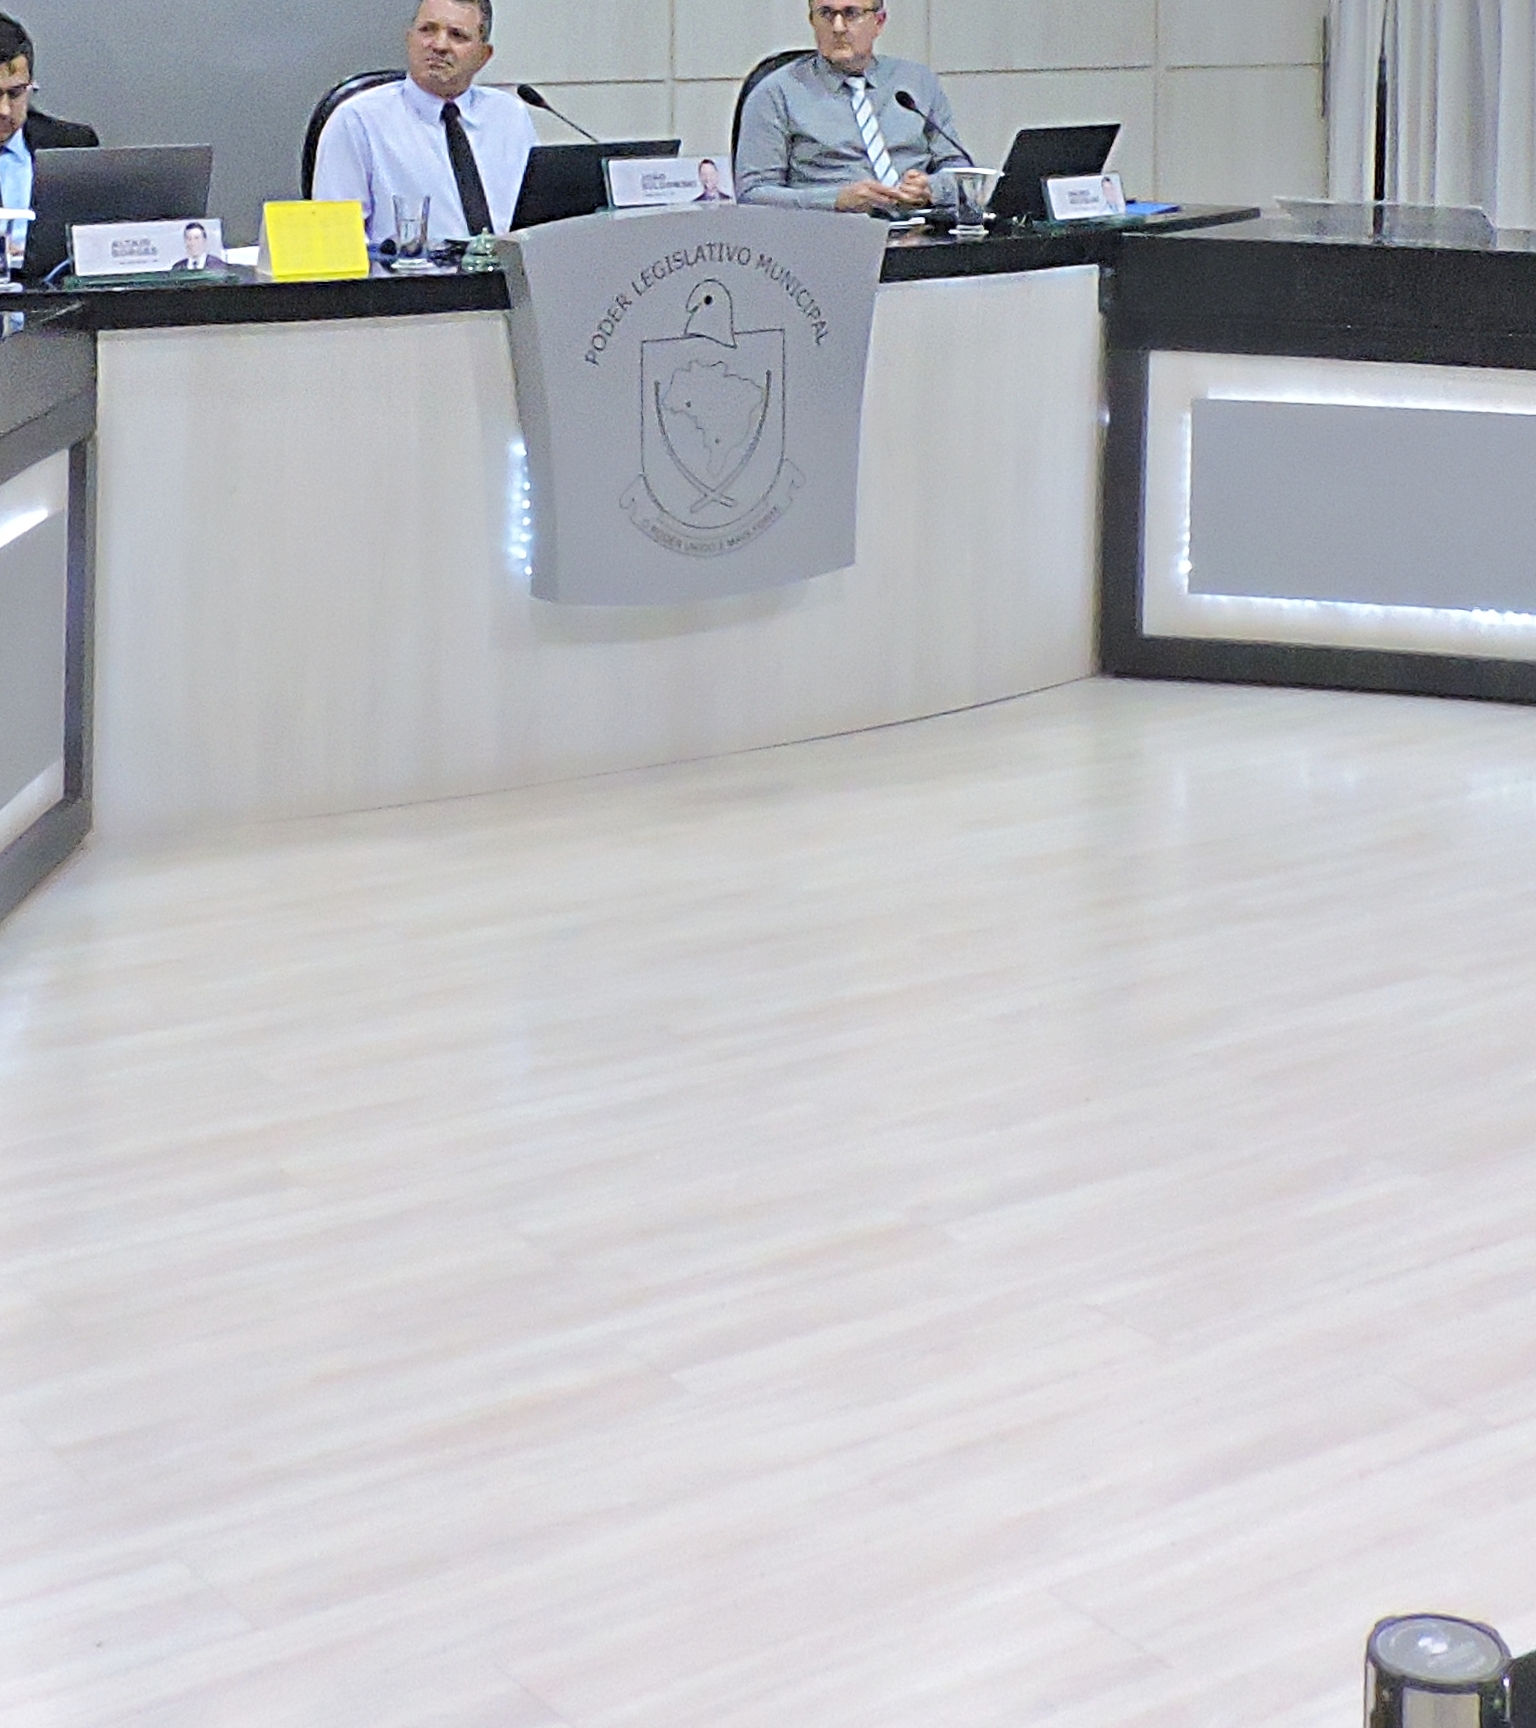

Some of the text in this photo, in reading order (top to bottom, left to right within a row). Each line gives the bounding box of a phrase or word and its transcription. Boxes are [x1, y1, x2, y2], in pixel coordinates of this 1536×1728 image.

[585, 242, 829, 366] PODER LEGISLATIVO MUNICIPAL
